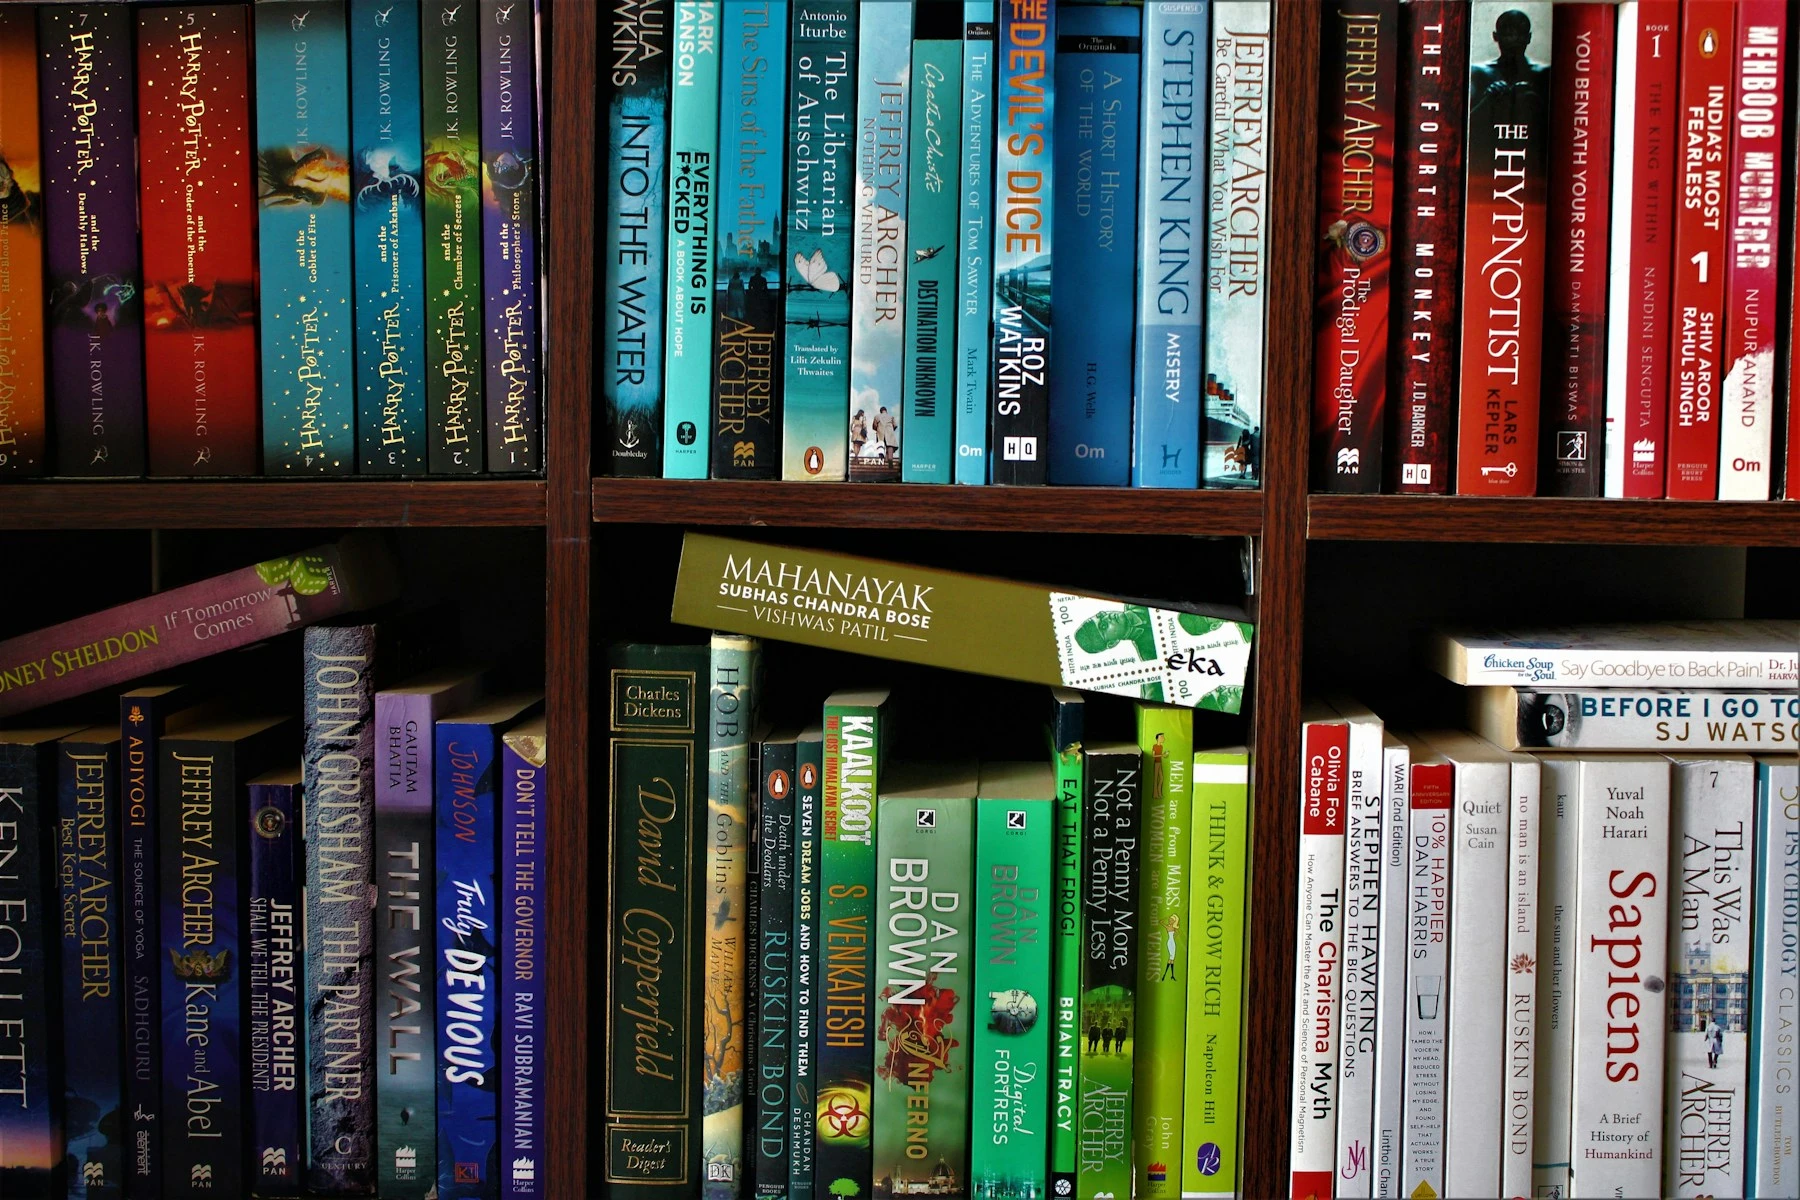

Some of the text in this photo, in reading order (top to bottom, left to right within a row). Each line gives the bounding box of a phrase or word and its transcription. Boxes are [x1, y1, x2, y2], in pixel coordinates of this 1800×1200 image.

[800, 9, 847, 22] Antonio
[70, 32, 97, 175] HARRY POTTER
[179, 32, 205, 176] HARRY POTTER
[822, 51, 847, 237] The Librarian
[1076, 69, 1094, 217] OF THE WORLD
[1338, 9, 1382, 217] JEFFREY ARCHER
[1569, 31, 1591, 273] YOU BENEATH YOUR SKIN
[1685, 106, 1704, 209] FEARLESS
[873, 78, 903, 326] JEFFREY ARCHER
[966, 52, 987, 316] THE ADVENTURES OF TOM SAWYER
[1158, 29, 1195, 315] STEPHEN KING
[1224, 27, 1270, 301] JEFFREY ARCHER
[79, 193, 89, 274] Deathly Hallows
[389, 194, 399, 292] Prisoner of Azkaban
[512, 192, 523, 290] Philosopher's Stone
[616, 115, 650, 386] INTO THE WATER
[691, 152, 709, 315] EVERYTHING IS
[1357, 278, 1371, 303] The
[88, 334, 104, 436] J.K. ROWLING
[298, 307, 323, 449] HARRY POTTER
[442, 300, 469, 445] HARRY POTTER
[746, 331, 775, 424] JEFFREY
[790, 356, 842, 365] Lilit Zekulin
[966, 348, 978, 414] Mark Twain
[1021, 337, 1045, 386] ROZ
[1334, 268, 1361, 436] Prodigal Daughter
[1568, 281, 1581, 421] DAMYANTI BISWAS
[1679, 307, 1697, 426] RAHUL SINGH
[1696, 312, 1714, 422] SHIV AROOR
[305, 455, 314, 467] 4
[1503, 400, 1518, 445] LARS
[1732, 458, 1761, 472] Om
[194, 612, 254, 641] Comes
[719, 582, 931, 629] SUBHAS CHANDRA BOSE
[722, 554, 934, 613] MAHANAYAK
[624, 702, 681, 718] Dickens
[626, 686, 679, 700] Charles
[1483, 653, 1554, 673] Chicken Soup
[312, 652, 367, 903] JOHN GRISHAM
[448, 741, 478, 843] JOHNSON
[1309, 756, 1324, 817] Cabane
[1325, 746, 1341, 827] Olivia Fox
[1463, 800, 1502, 817] Quiet
[1466, 824, 1497, 835] Susan
[1606, 787, 1644, 800] Yuval
[61, 818, 77, 938] Best Kept Secret
[66, 751, 112, 1002] JEFFREY ARCHER
[778, 814, 791, 891] Death under
[1060, 779, 1077, 937] EAT THAT FROG!
[1085, 780, 1114, 960] Not a Penny Less
[1414, 836, 1429, 958] DAN HARRIS
[1468, 837, 1494, 848] Cain
[1682, 834, 1711, 932] A Man
[1712, 821, 1744, 944] This Was
[621, 776, 677, 1081] David Copperfield
[797, 795, 812, 1077] SEVEN DREAM JOBS AND HOW TO FIND THEM
[888, 858, 929, 1005] BROWN
[929, 892, 959, 973] DAN
[989, 864, 1019, 965] BROWN
[1345, 770, 1362, 1078] BRIEF ANSWERS TO THE BIG QUESTIONS
[1359, 796, 1380, 1053] STEPHEN HAWKING
[271, 898, 295, 1091] JEFFREY ARCHER
[317, 921, 362, 1104] THE PARTNER
[1311, 888, 1339, 1120] The Charisma Myth
[1591, 870, 1657, 1083] Sapiens
[185, 983, 222, 1138] Kane and Abel
[514, 992, 533, 1149] RAVI SUBRAMANIAN
[761, 930, 787, 1158] RUSKIN BOND
[993, 1050, 1009, 1145] FORTRESS
[1200, 1034, 1217, 1124] Napoleon Hill
[1512, 994, 1531, 1155] RUSKIN BOND
[1584, 1149, 1653, 1160] Humankind
[1707, 1087, 1735, 1177] JEFFREY
